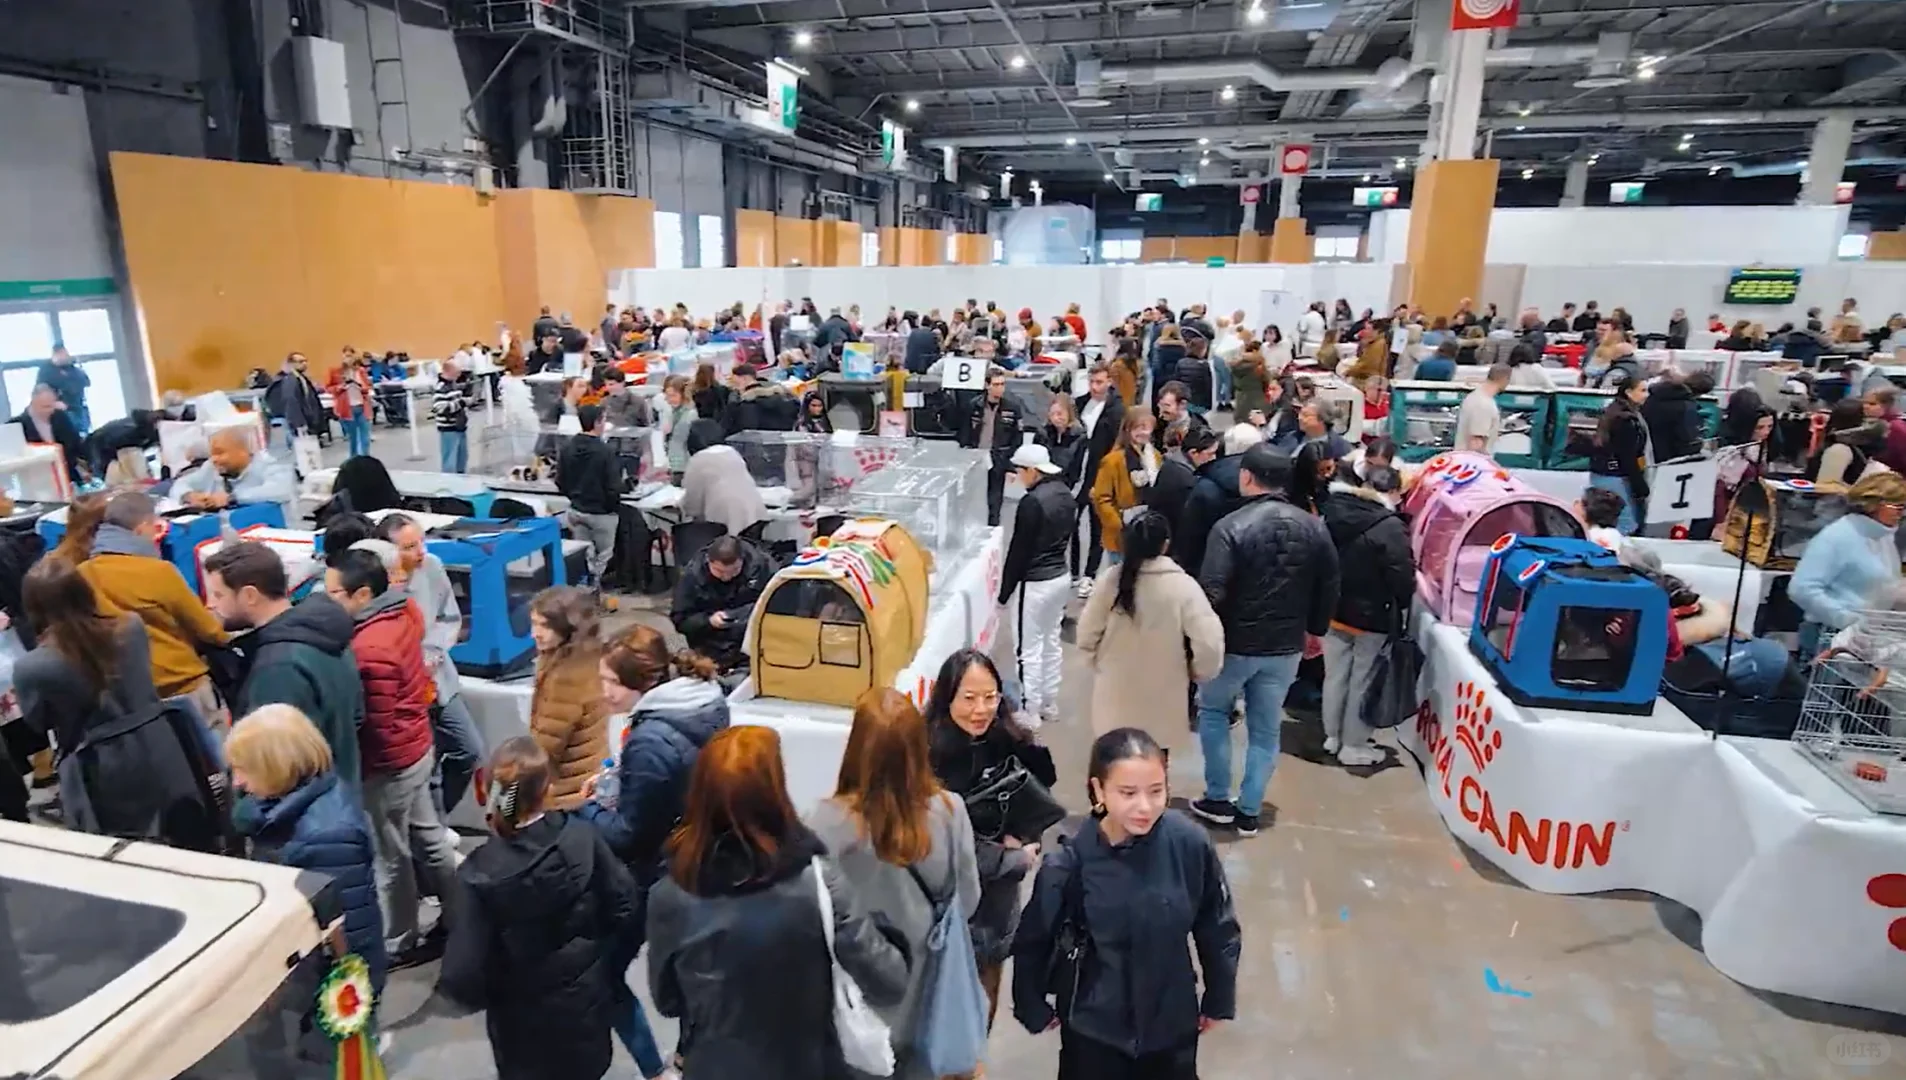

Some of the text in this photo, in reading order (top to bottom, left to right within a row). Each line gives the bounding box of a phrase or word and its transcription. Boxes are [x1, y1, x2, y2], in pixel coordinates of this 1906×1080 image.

[958, 362, 972, 382] B
[1670, 472, 1694, 509] I
[1415, 698, 1617, 870] ROYAL CANIN
